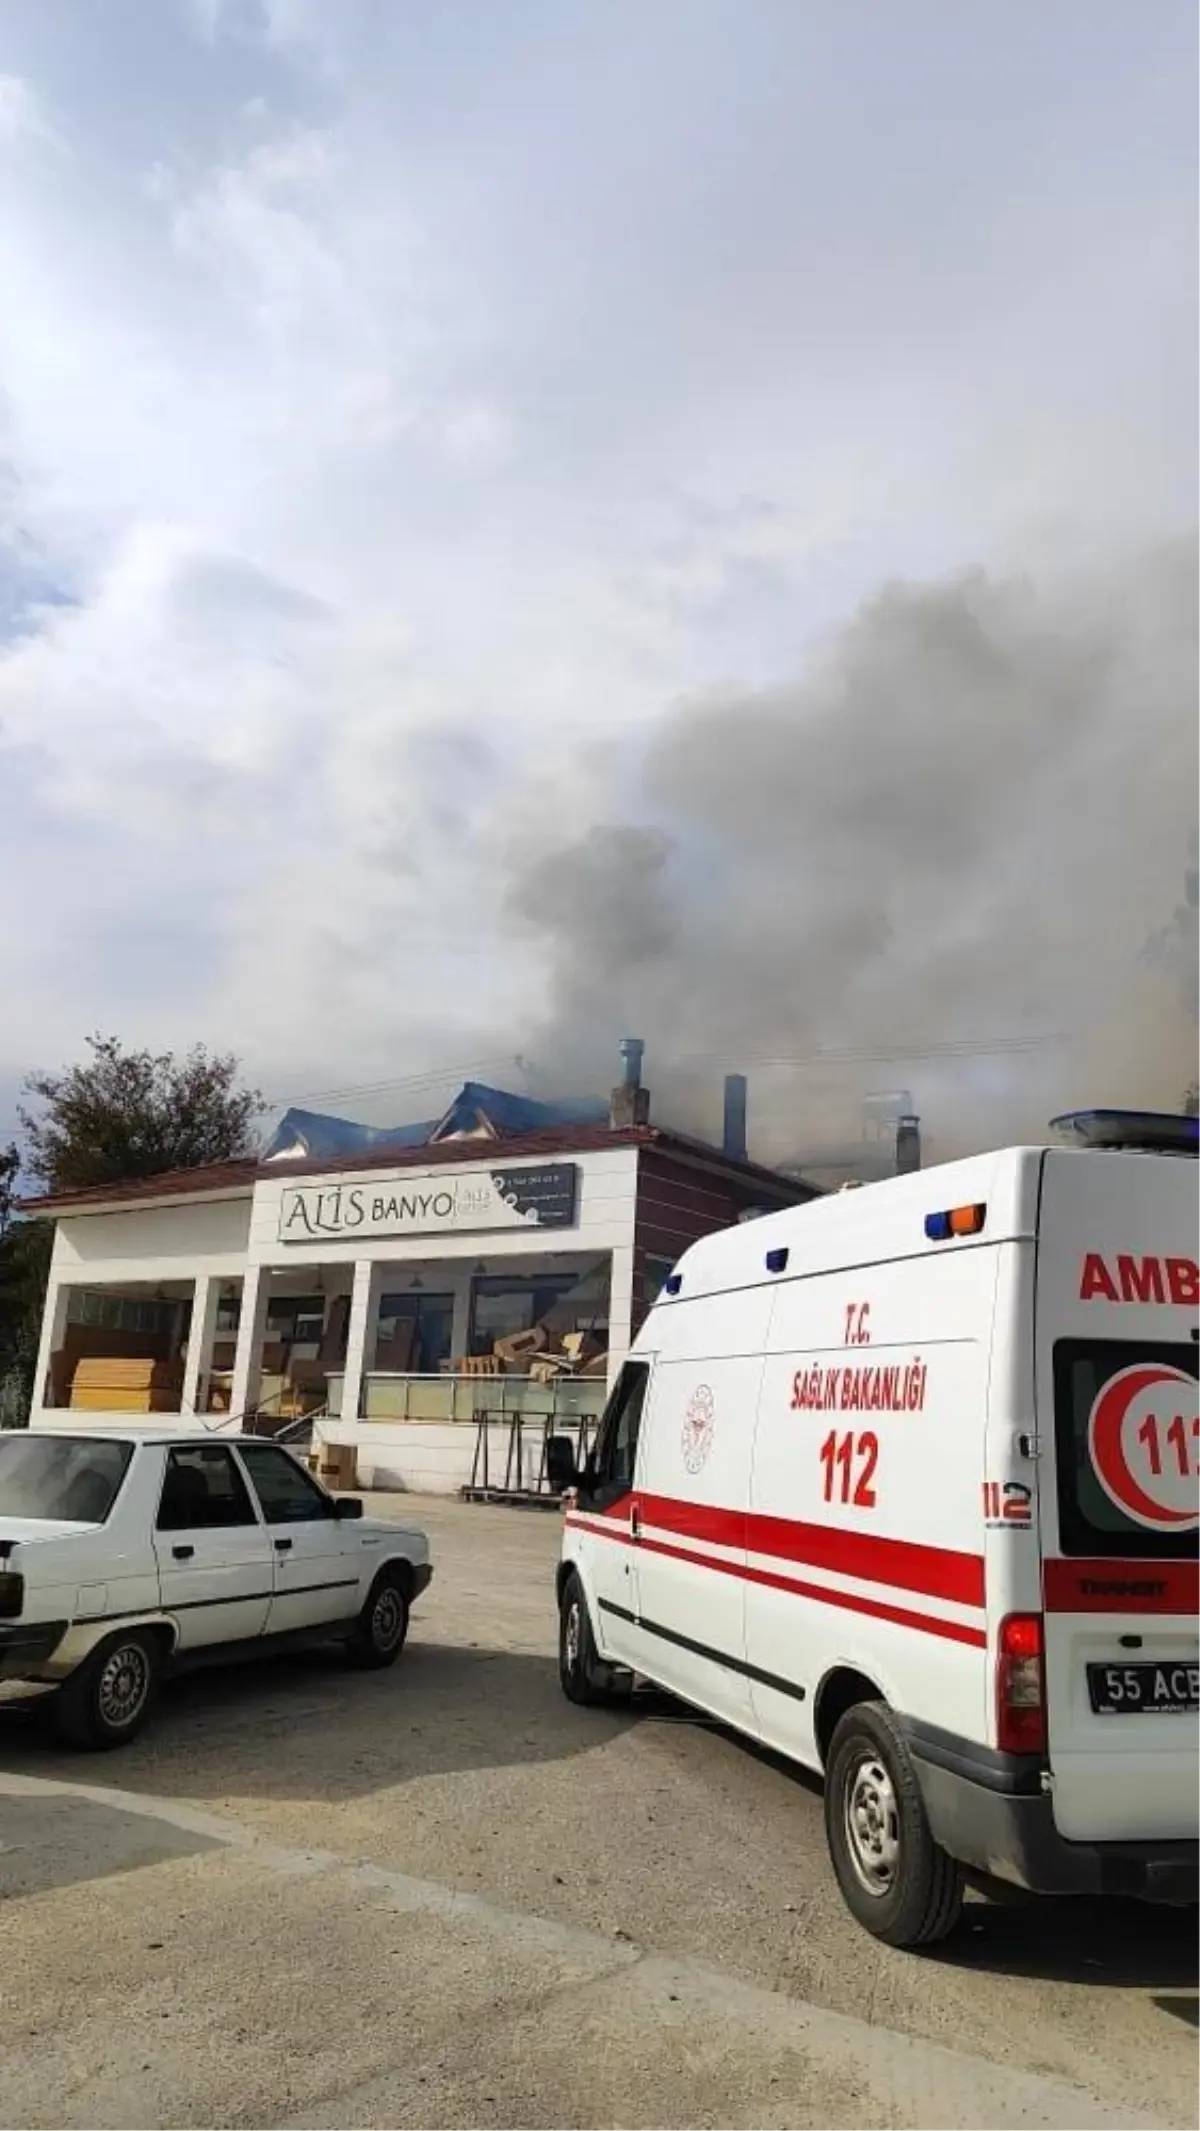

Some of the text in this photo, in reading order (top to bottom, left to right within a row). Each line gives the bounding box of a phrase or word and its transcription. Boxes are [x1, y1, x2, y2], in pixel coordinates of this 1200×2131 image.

[372, 1192, 453, 1222] BANYO
[1080, 1252, 1200, 1305] AMB
[790, 1356, 927, 1412] SAĞLIK BAKANLIĞI
[819, 1430, 879, 1508] 112
[982, 1481, 1032, 1519] 112
[1107, 1669, 1141, 1700] 55
